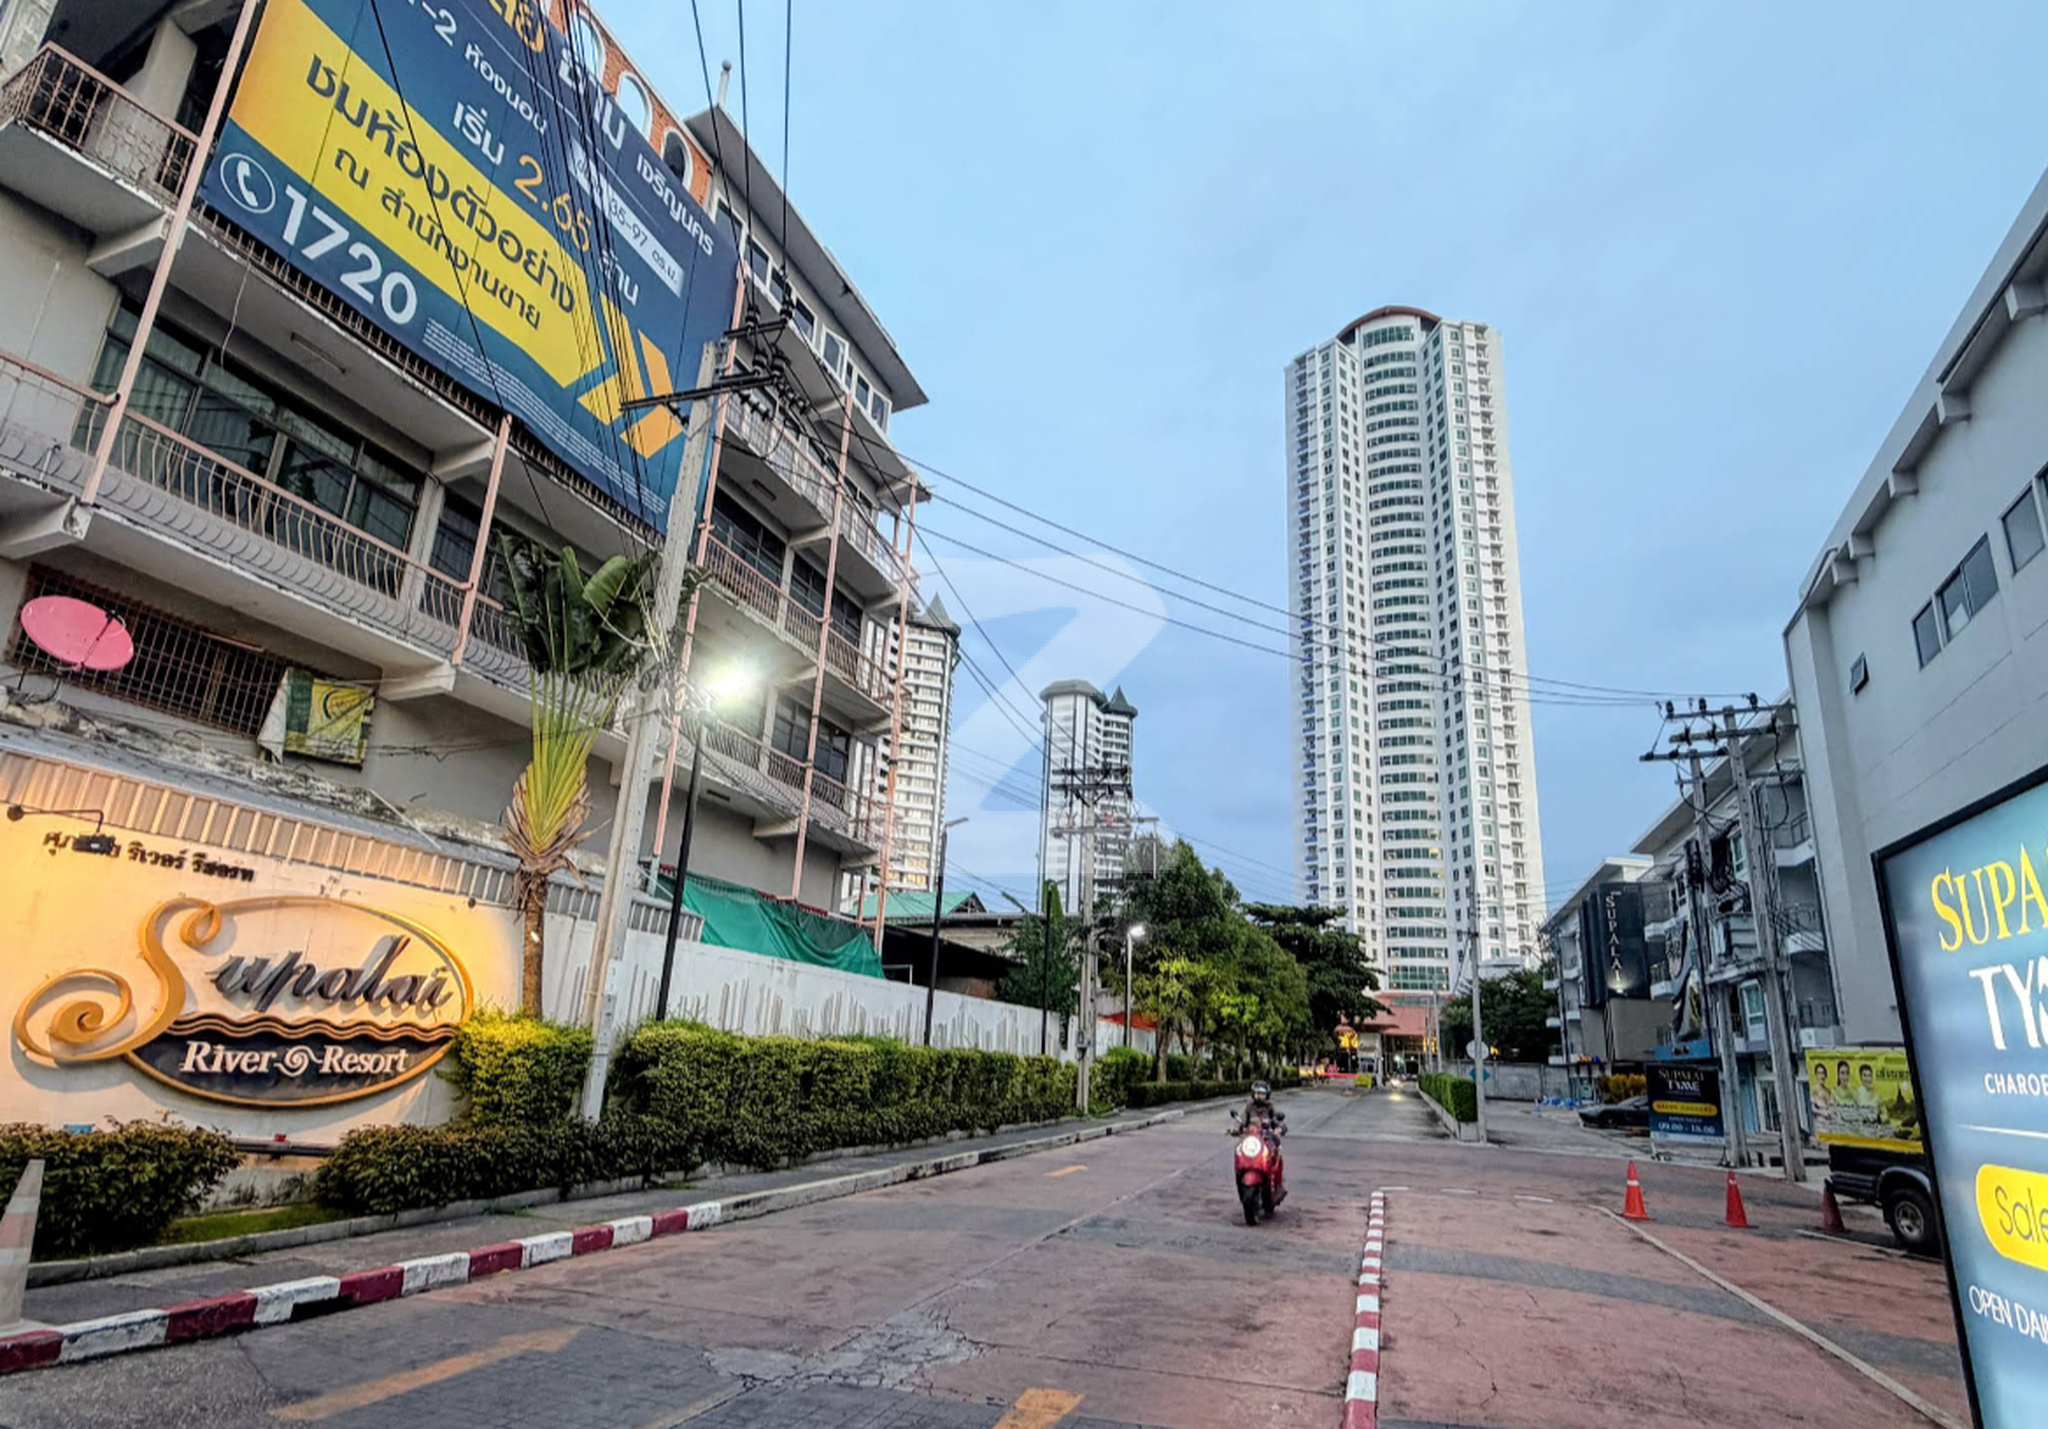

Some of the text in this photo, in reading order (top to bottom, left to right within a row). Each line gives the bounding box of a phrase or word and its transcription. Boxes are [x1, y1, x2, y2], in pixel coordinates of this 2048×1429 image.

[464, 42, 548, 134] ห้องนอน
[305, 53, 575, 314] ชมห้องตัวอย่าง
[452, 101, 505, 166] เริ่ม
[514, 154, 593, 253] 2.65
[635, 152, 715, 257] เจริญนคร
[281, 184, 418, 325] 1720
[333, 147, 542, 331] ณ สำนักงานขาย
[10, 896, 456, 1067] Supalai
[1605, 891, 1623, 982] SUPALAI
[180, 1041, 409, 1075] River Resort
[1968, 1284, 2015, 1330] OPEN
